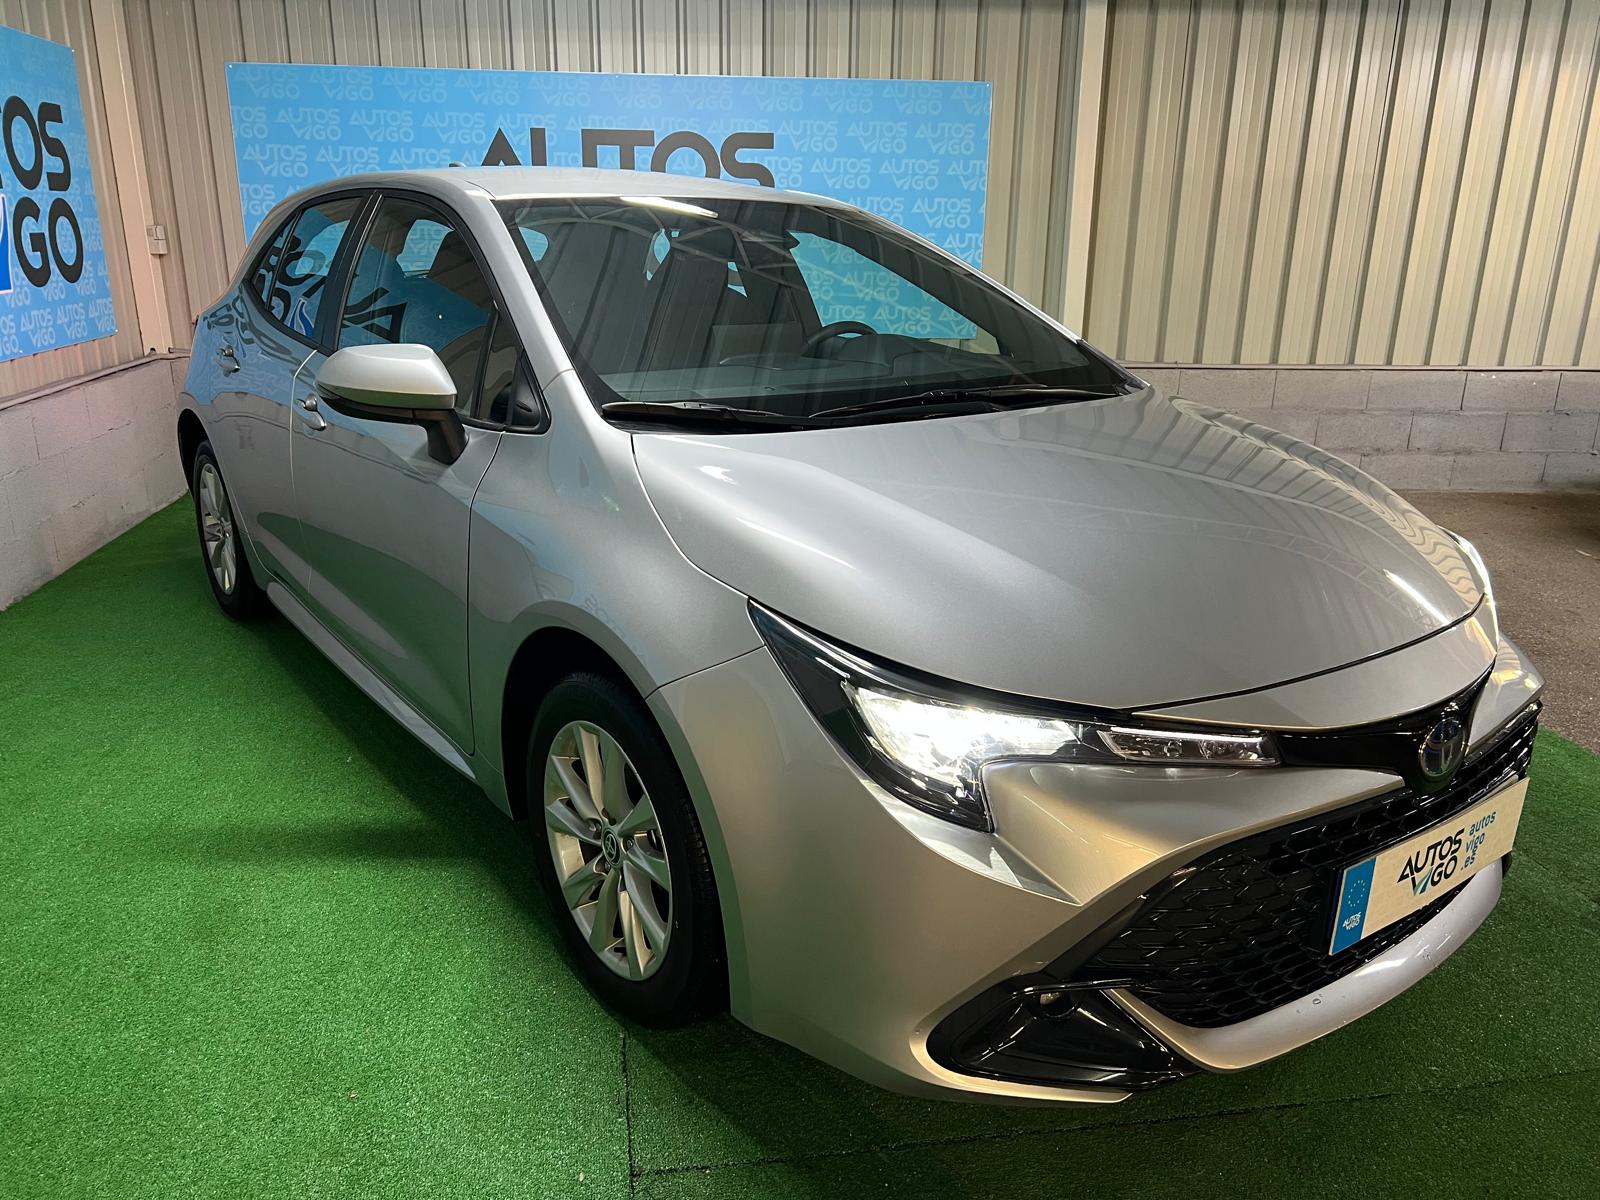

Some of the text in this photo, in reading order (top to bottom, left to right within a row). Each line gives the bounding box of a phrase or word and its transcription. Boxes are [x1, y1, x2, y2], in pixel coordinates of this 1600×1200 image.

[276, 107, 340, 124] AUTOS
[351, 109, 413, 127] AUTOS
[424, 111, 485, 128] AUTOS
[779, 119, 838, 136] AUTOS
[849, 121, 907, 137] AUTOS
[917, 123, 976, 139] AUTOS
[2, 95, 71, 192] OS
[244, 144, 307, 161] AUTOS
[317, 146, 380, 163] AUTOS
[812, 158, 871, 173] AUTOS
[881, 159, 940, 174] AUTOS
[914, 198, 971, 213] AUTOS
[1470, 811, 1497, 835] autos
[1465, 833, 1486, 853] vigo
[1397, 828, 1465, 883] AUTOS
